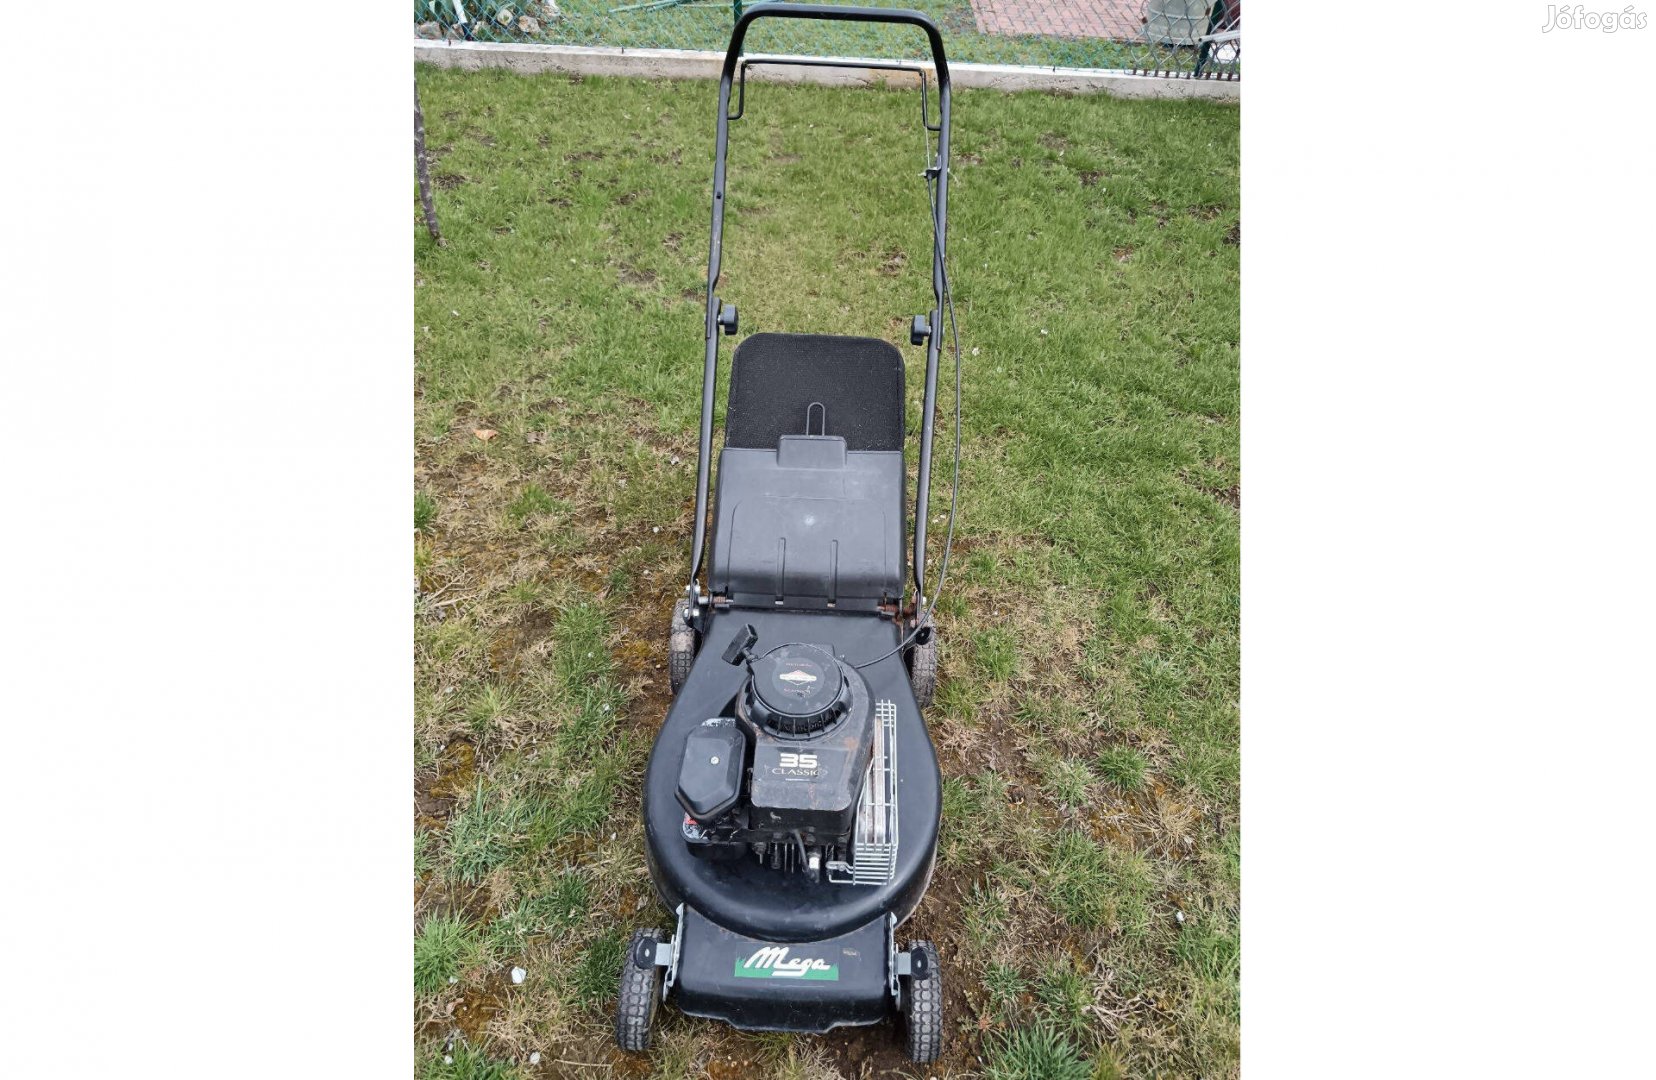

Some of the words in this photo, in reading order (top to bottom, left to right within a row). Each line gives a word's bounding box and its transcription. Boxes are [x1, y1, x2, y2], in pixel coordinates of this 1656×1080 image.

[779, 752, 817, 768] 35
[771, 768, 818, 776] CLASSIC
[743, 946, 831, 976] Mega
